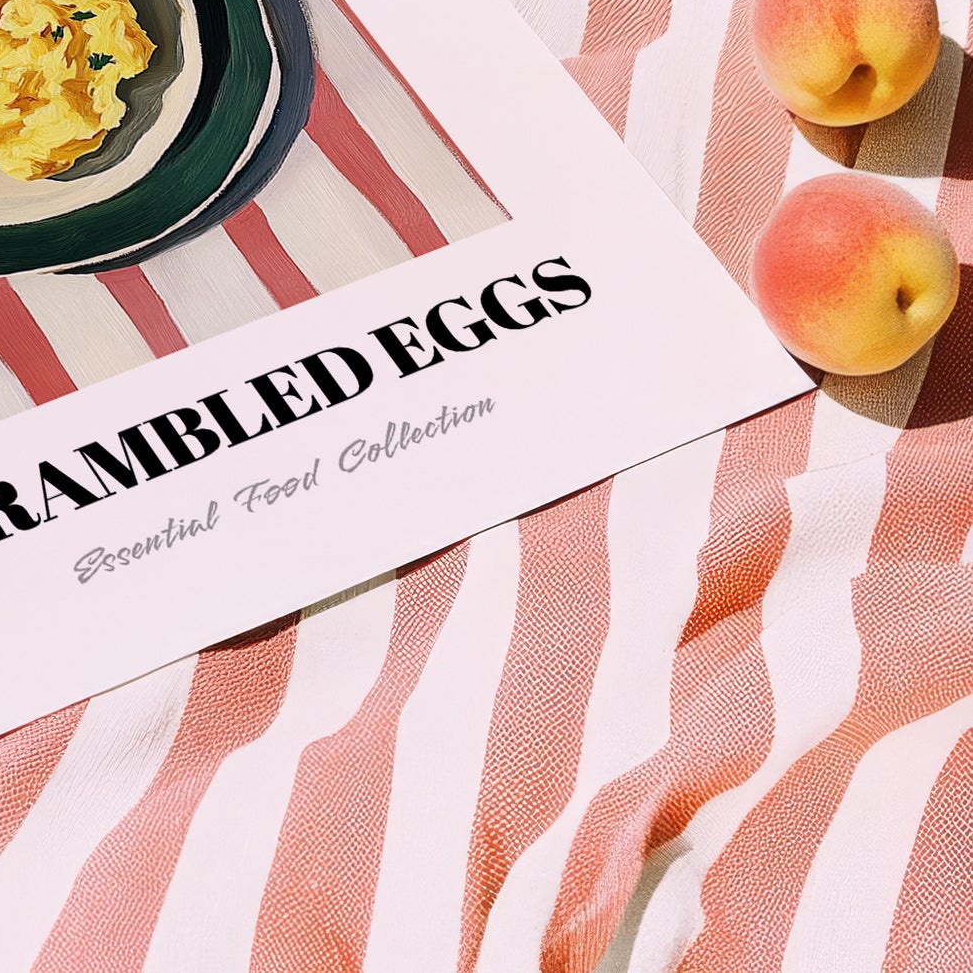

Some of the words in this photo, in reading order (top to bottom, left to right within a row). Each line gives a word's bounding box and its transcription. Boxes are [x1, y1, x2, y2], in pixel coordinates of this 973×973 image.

[367, 256, 592, 379] EGGS
[73, 500, 221, 585] Essential
[233, 457, 321, 514] Food
[338, 397, 497, 474] Collection
